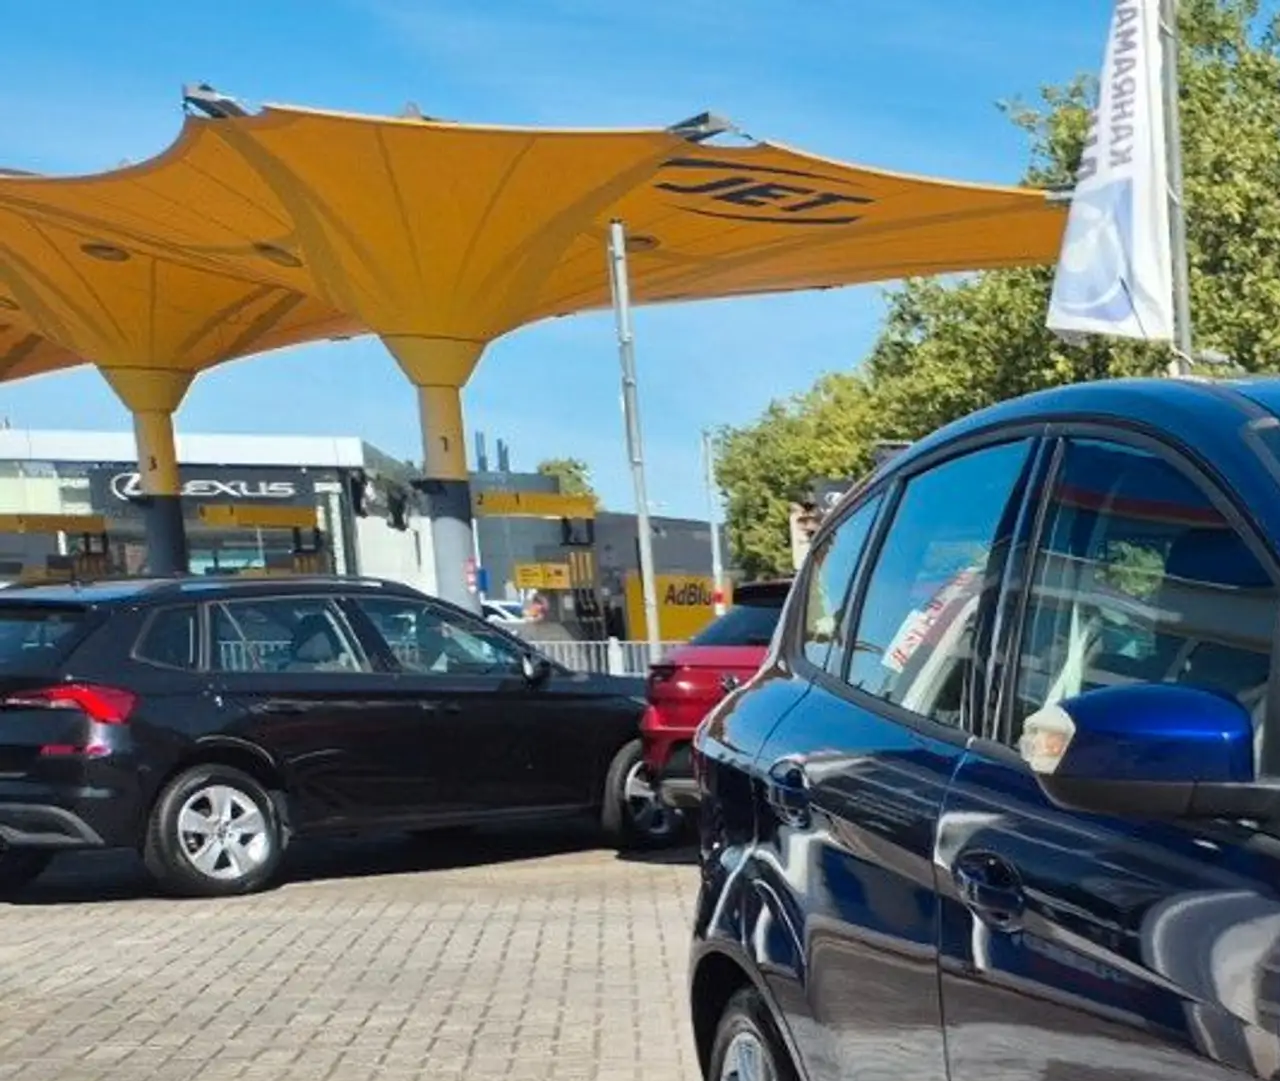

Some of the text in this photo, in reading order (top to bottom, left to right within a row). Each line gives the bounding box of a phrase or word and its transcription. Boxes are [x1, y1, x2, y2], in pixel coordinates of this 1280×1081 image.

[654, 176, 875, 213] JET
[180, 479, 296, 497] EXUS
[664, 583, 726, 606] AdBlu
